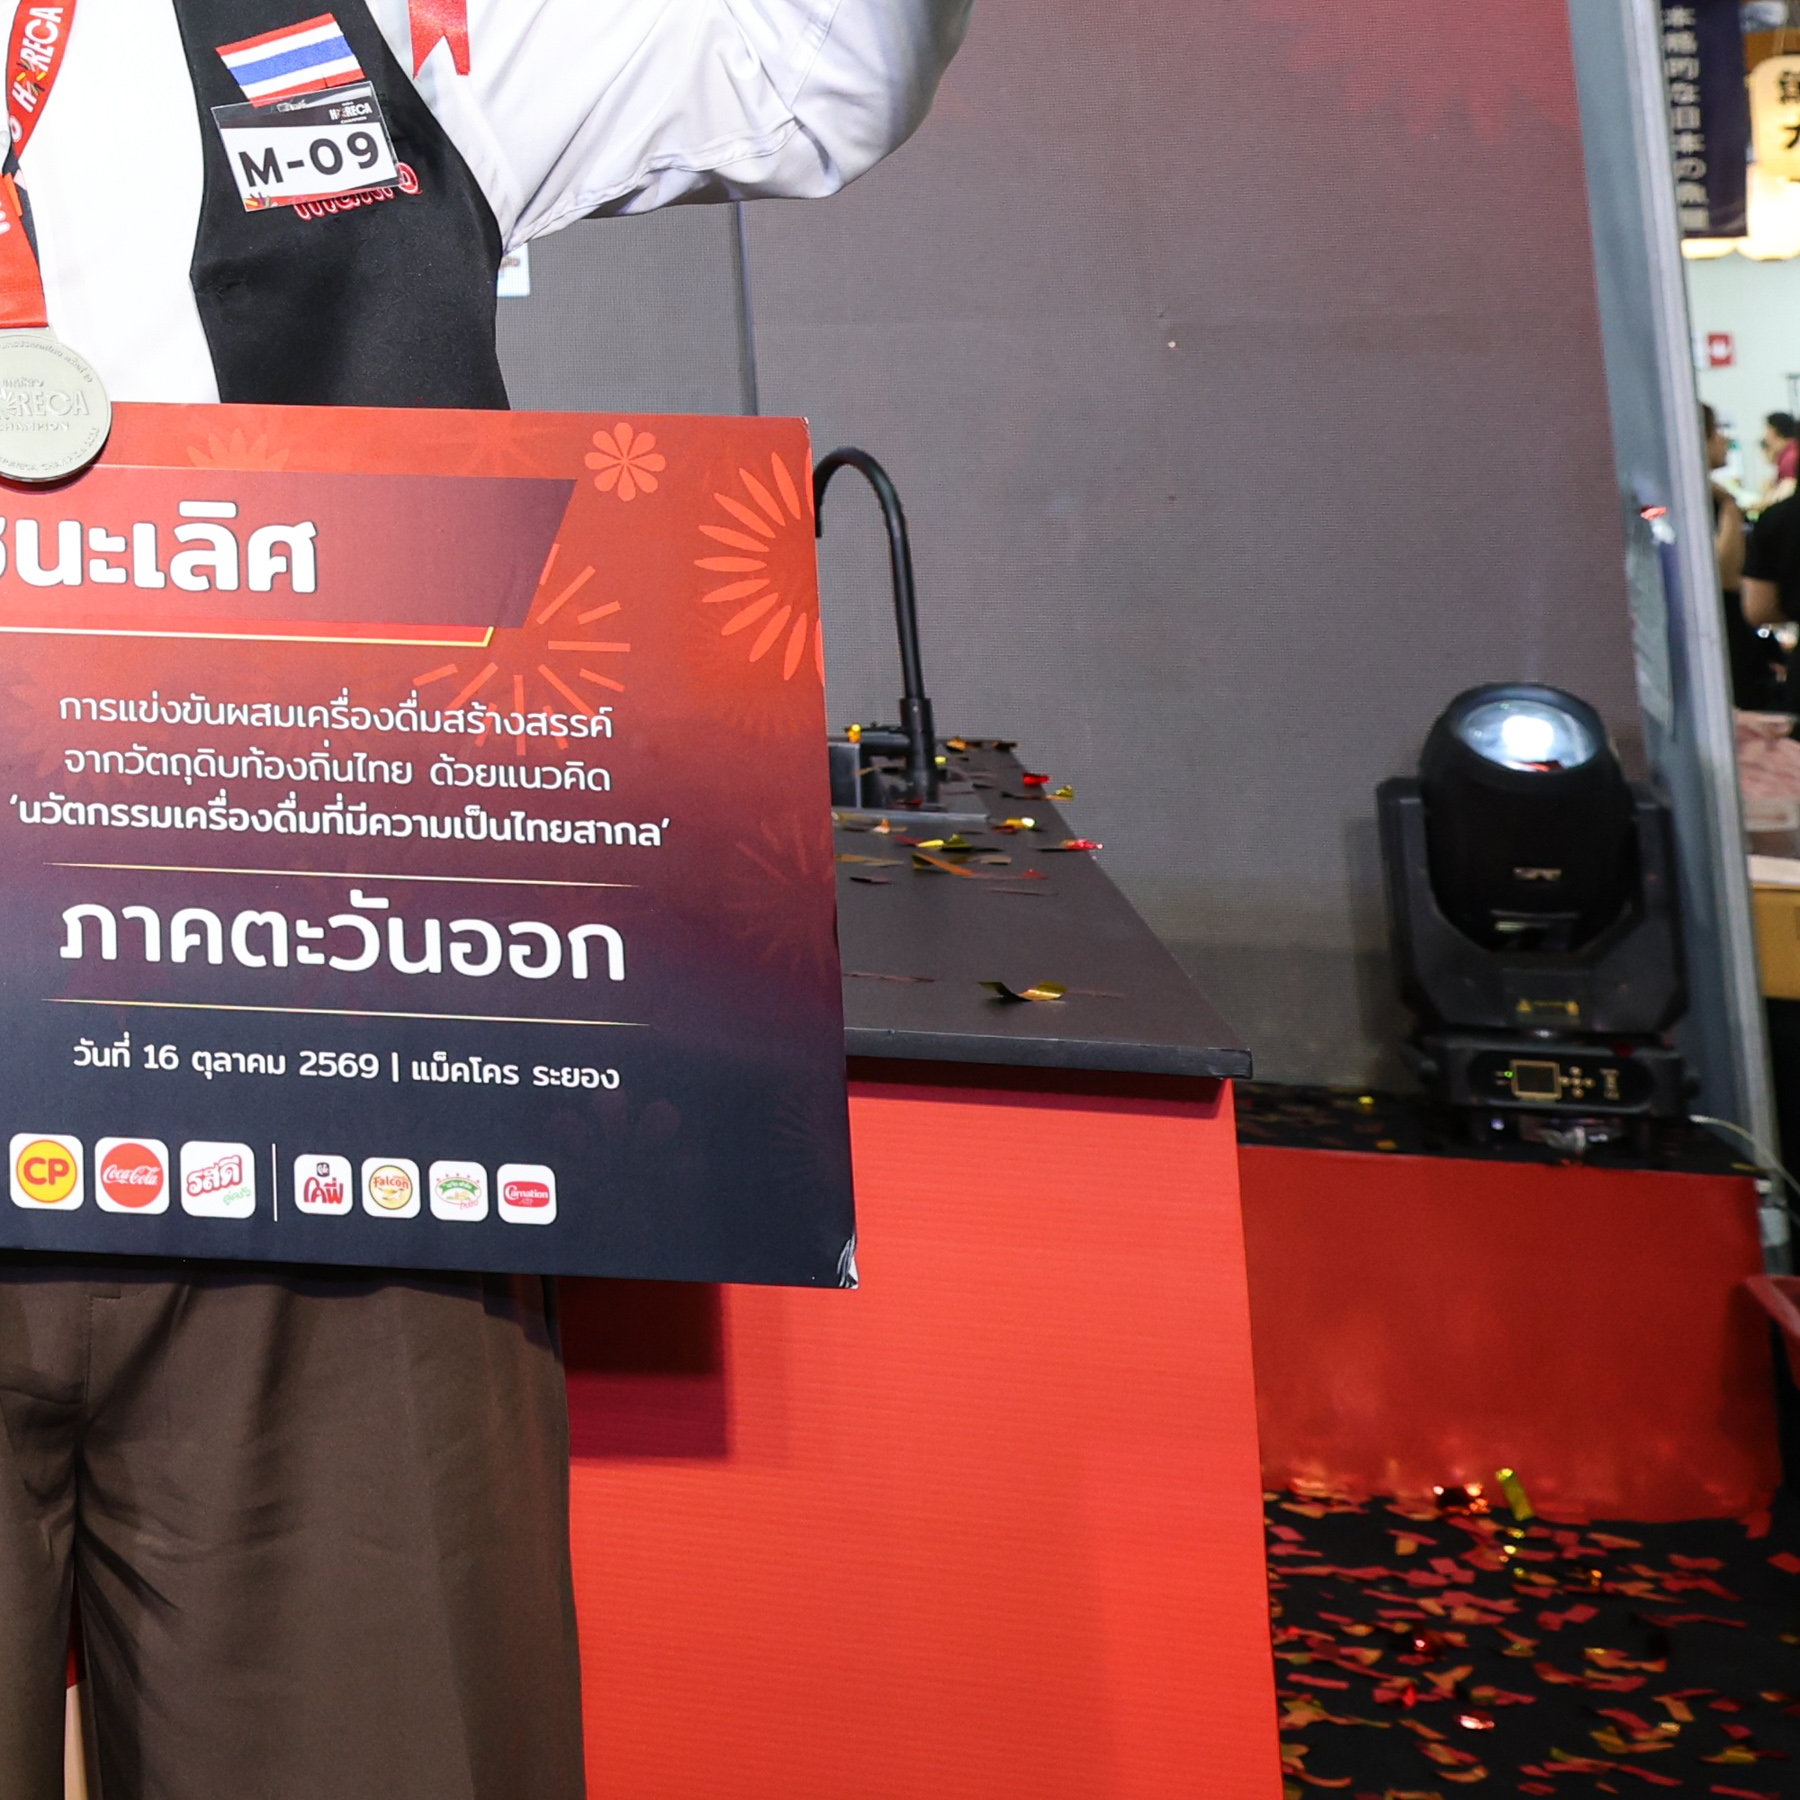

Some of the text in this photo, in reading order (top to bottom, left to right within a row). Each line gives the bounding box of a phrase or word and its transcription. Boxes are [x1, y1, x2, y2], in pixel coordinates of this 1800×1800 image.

[11, 7, 64, 113] HORECA
[239, 131, 379, 188] M-09
[59, 889, 626, 982] ภาคตะวันออก
